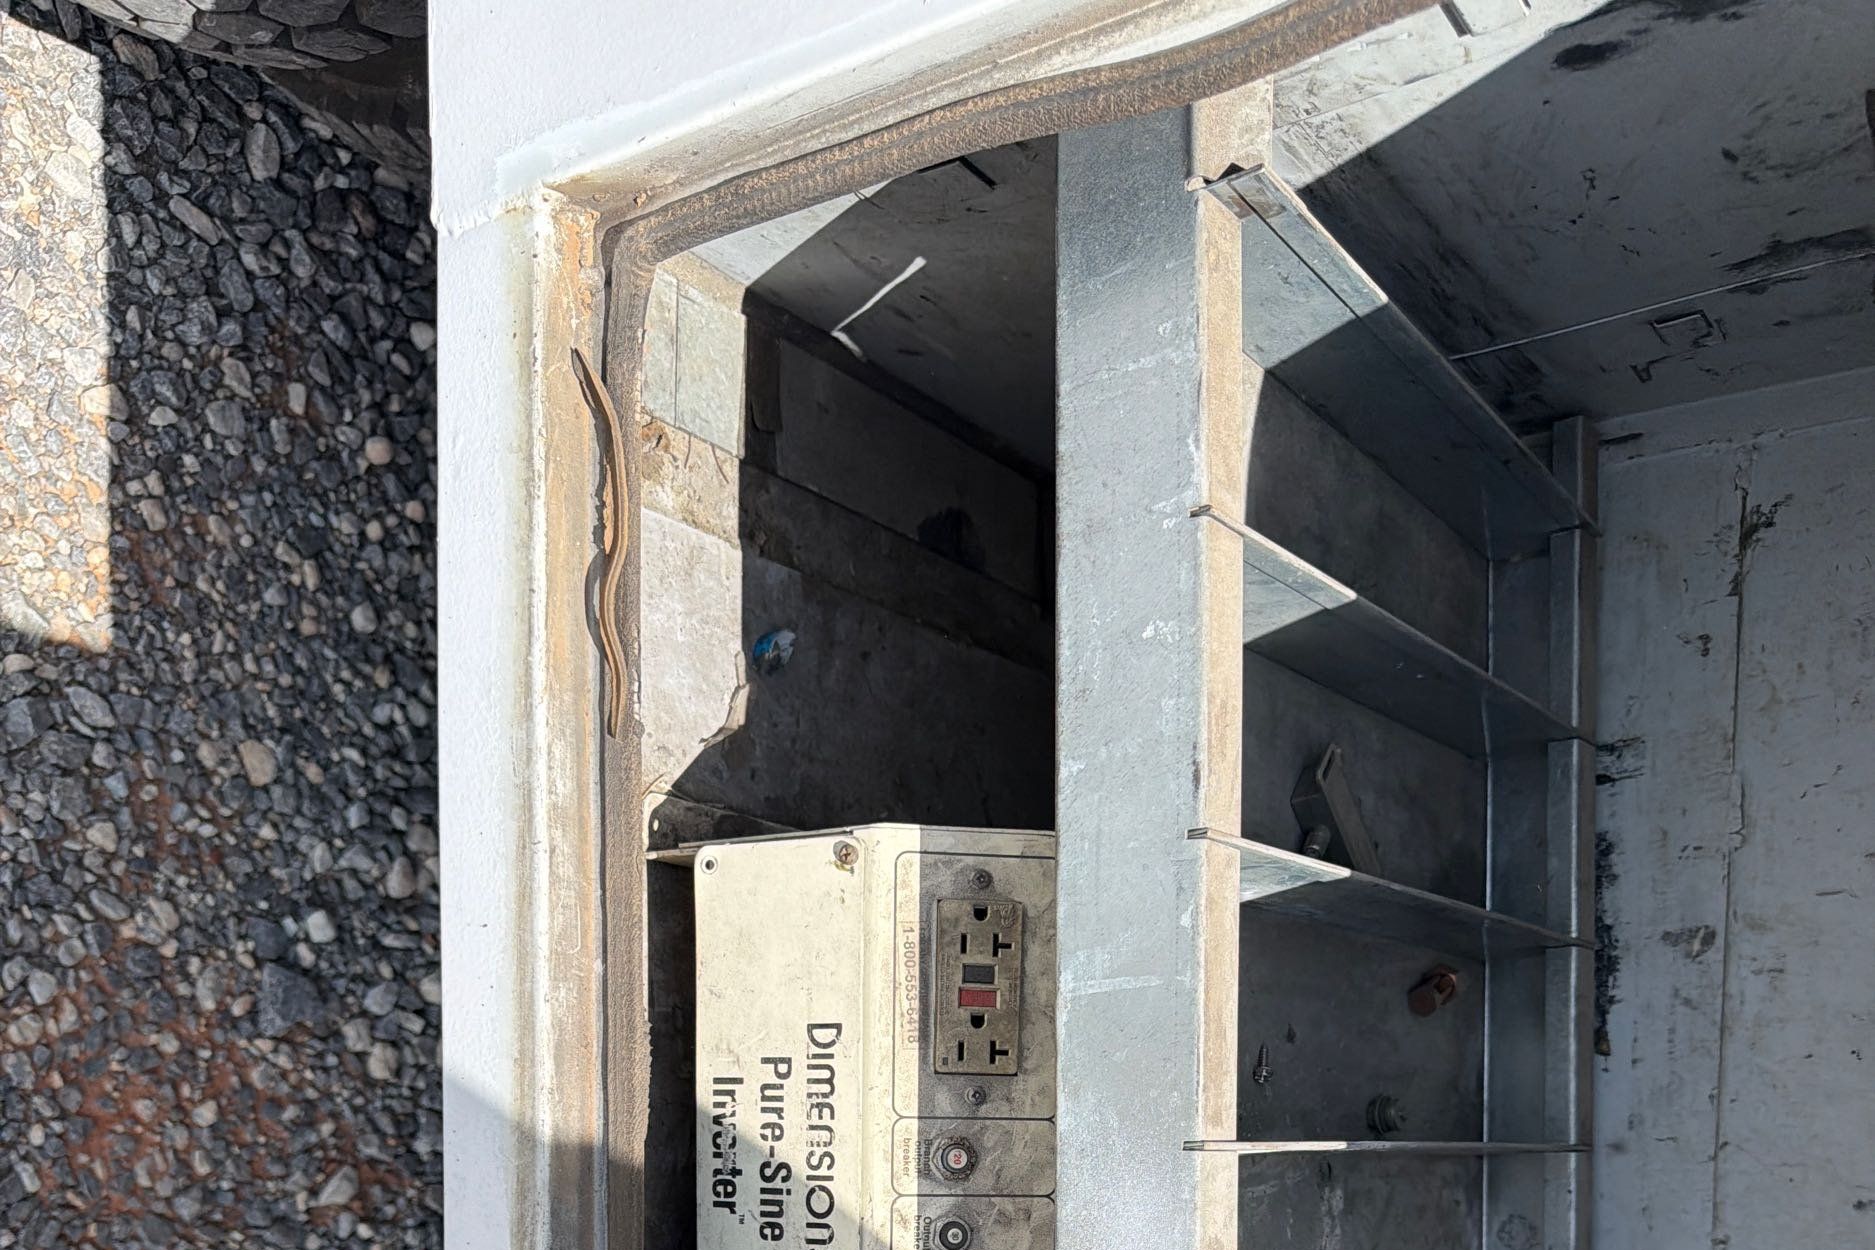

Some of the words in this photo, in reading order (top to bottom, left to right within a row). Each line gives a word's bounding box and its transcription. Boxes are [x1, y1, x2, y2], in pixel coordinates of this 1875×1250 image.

[903, 926, 919, 1044] 1-800-553-6418
[760, 1056, 792, 1241] Pure-Sine
[902, 1138, 910, 1177] breaker
[954, 1154, 962, 1164] 20
